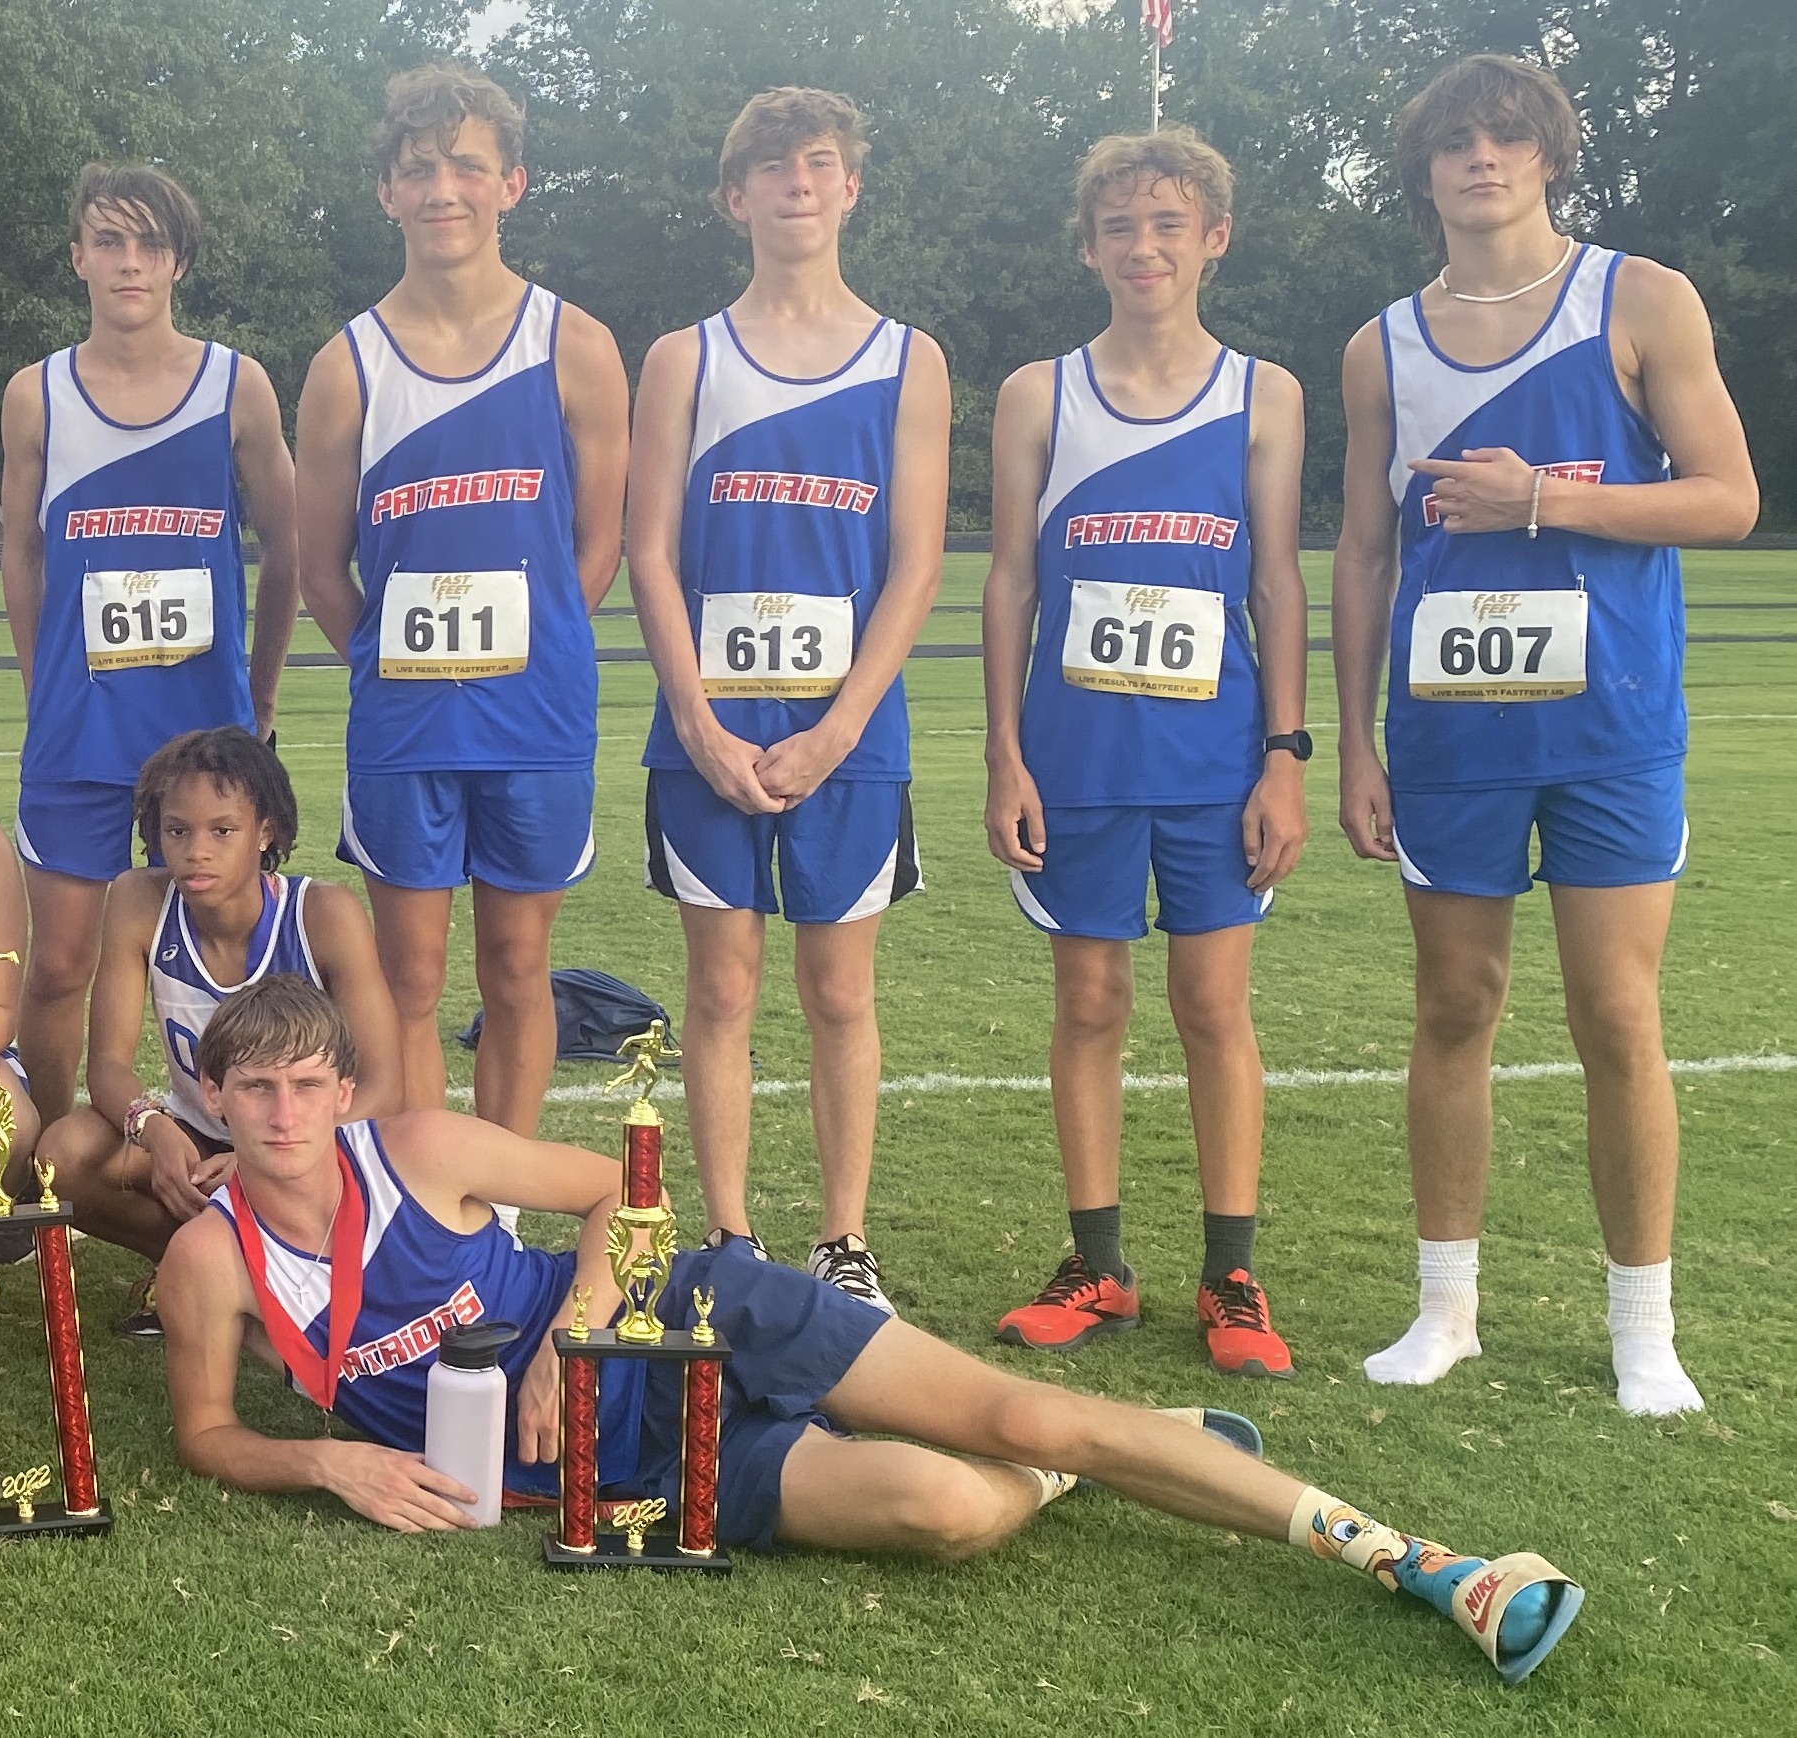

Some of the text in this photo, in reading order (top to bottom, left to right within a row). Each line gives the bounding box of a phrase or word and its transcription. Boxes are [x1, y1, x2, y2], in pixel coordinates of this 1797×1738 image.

[371, 469, 544, 525] PATRIOTS
[709, 471, 878, 515] PATRIOTS
[65, 506, 225, 539] PATRIOTS
[1064, 511, 1239, 550] PATRIOTS
[128, 579, 161, 597] FEET
[436, 584, 473, 604] FEET
[1129, 597, 1170, 616] FEET
[102, 599, 187, 644] 615
[404, 606, 493, 652] 611
[758, 604, 796, 623] FEET
[1478, 603, 1522, 624] FEET
[726, 625, 822, 672] 613
[1090, 617, 1195, 670] 616
[1440, 626, 1553, 676] 607
[1431, 689, 1452, 697] LIVE
[1455, 689, 1497, 697] RESULTS
[338, 1280, 484, 1383] ATRIOTS
[2, 1464, 52, 1499] 2022
[612, 1497, 667, 1528] 2022
[1465, 1571, 1500, 1618] NIKE
